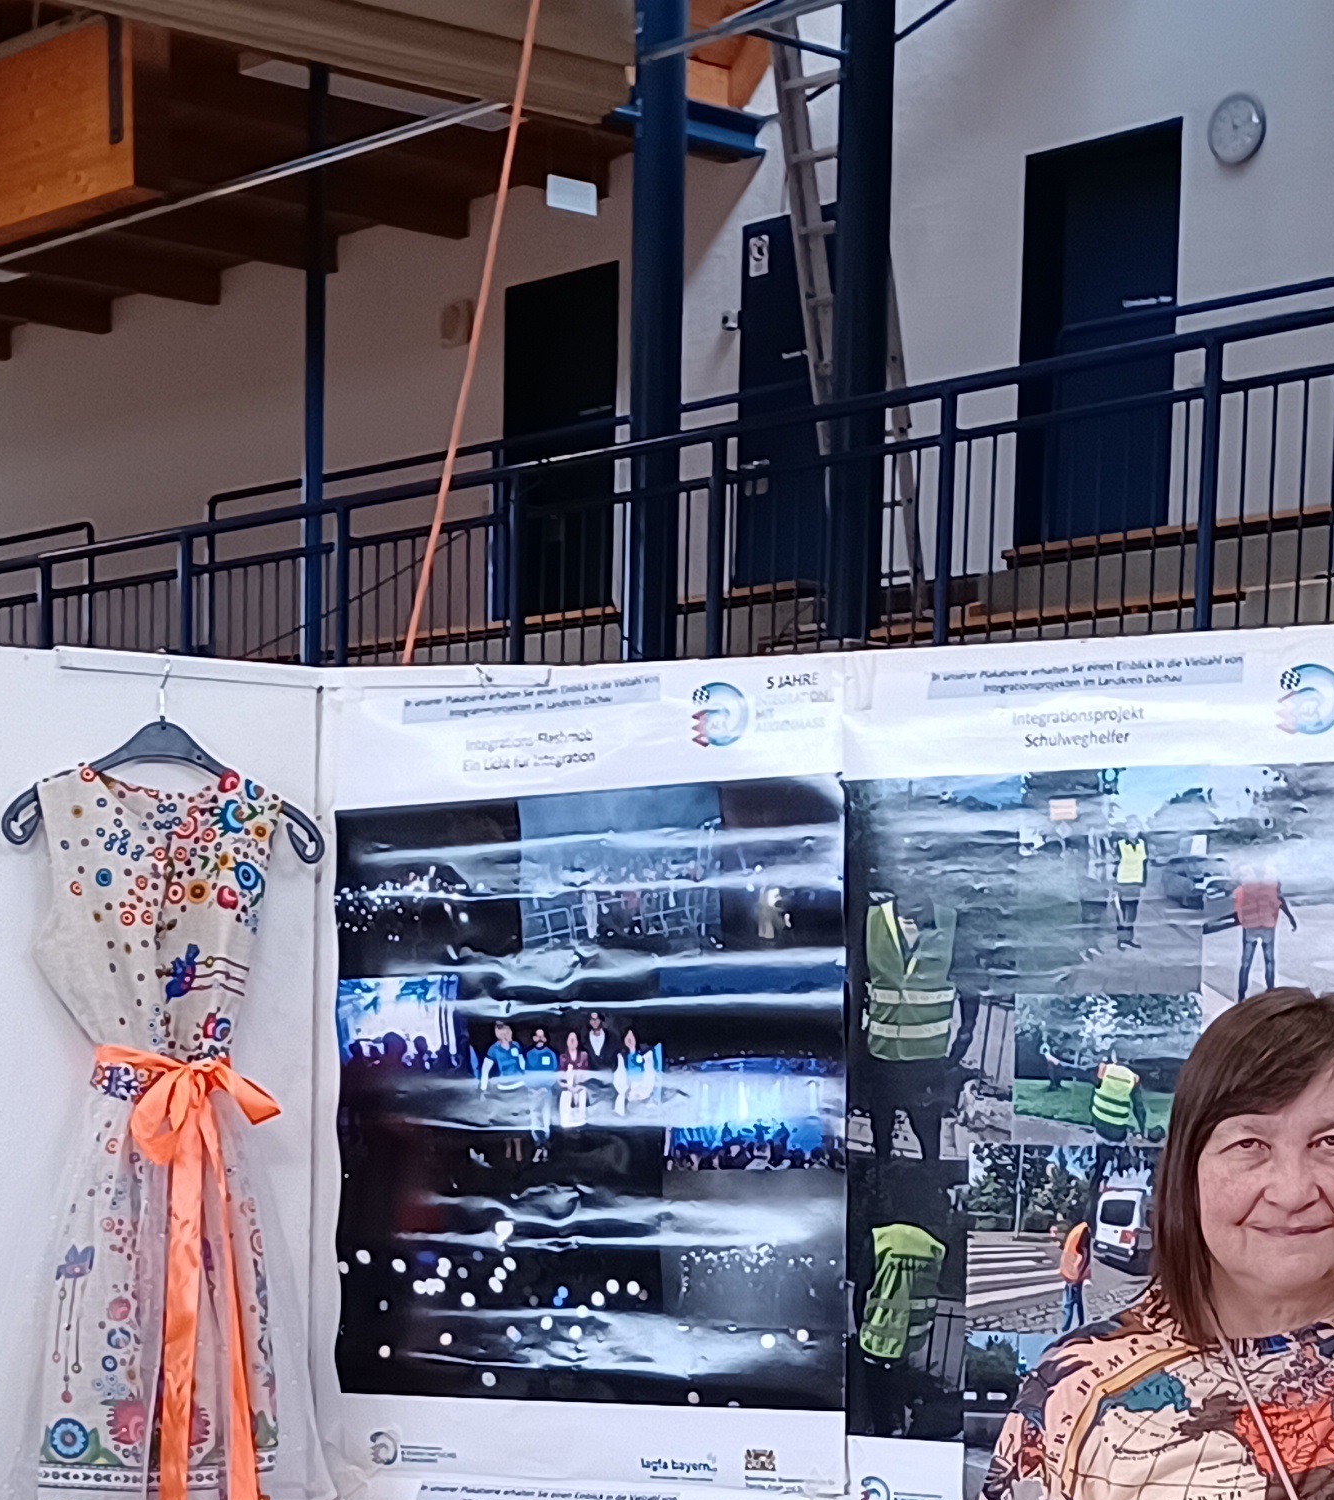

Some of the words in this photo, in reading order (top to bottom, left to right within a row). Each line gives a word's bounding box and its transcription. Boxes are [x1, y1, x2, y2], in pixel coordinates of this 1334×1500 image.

[766, 676, 775, 690] 5
[777, 672, 819, 689] JAHRE
[1012, 706, 1144, 727] Integrationsprojekt
[1025, 729, 1130, 749] Schulweghelfer
